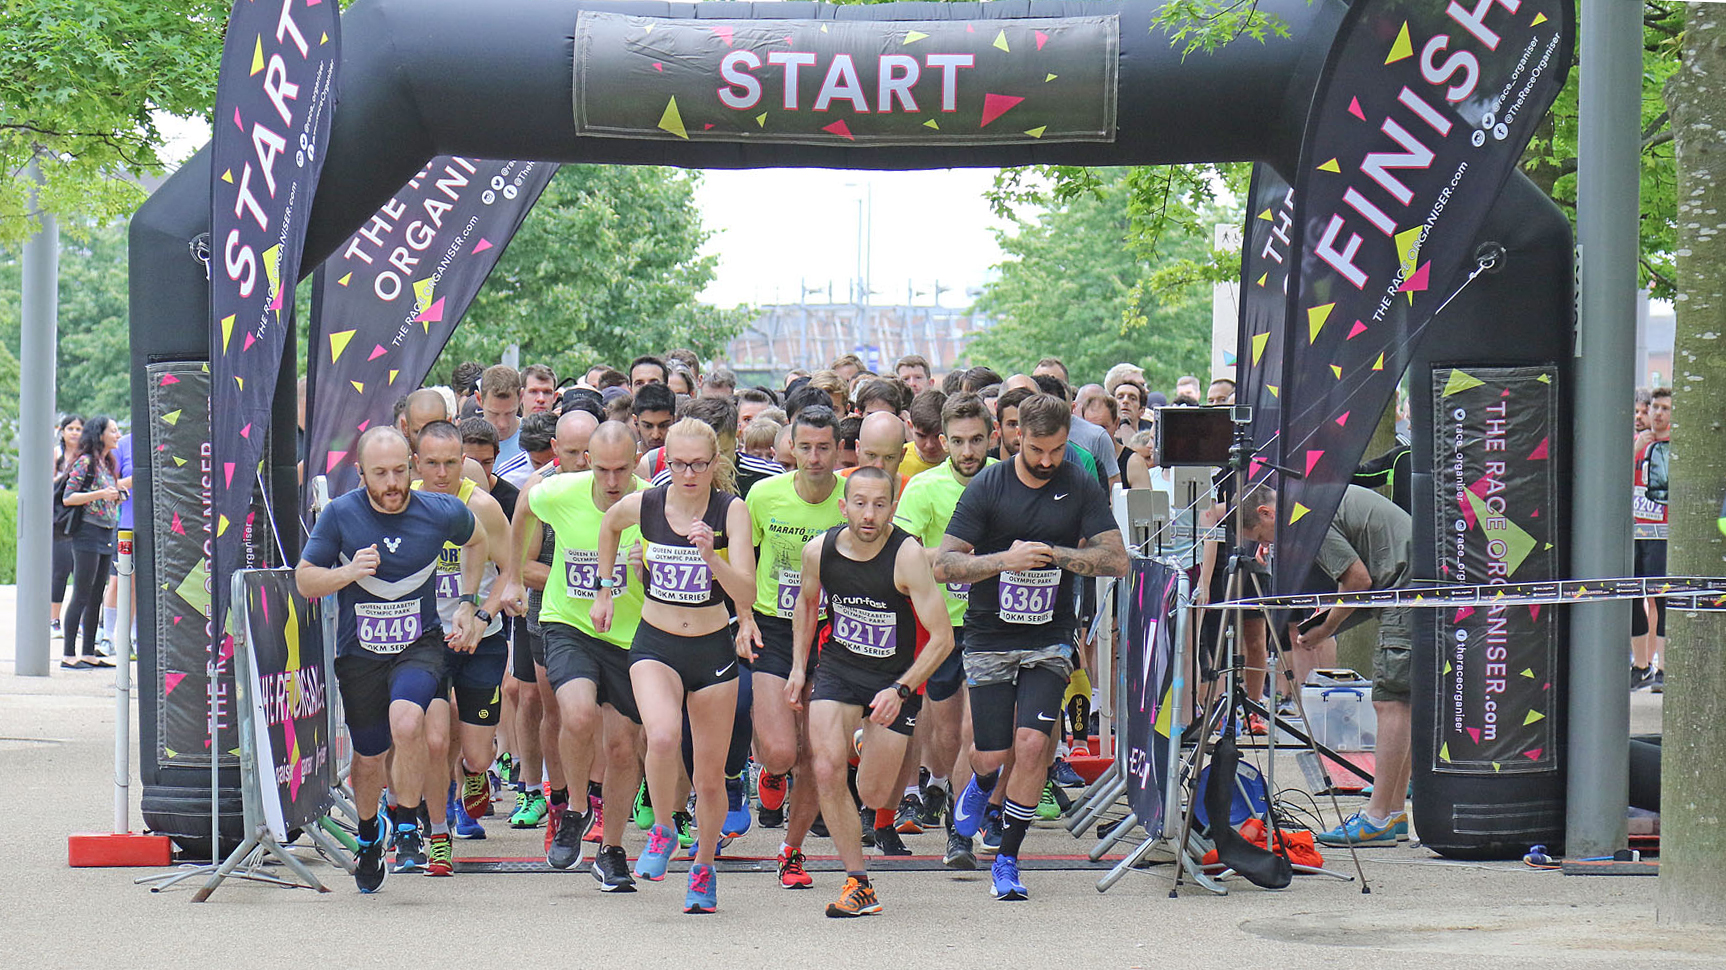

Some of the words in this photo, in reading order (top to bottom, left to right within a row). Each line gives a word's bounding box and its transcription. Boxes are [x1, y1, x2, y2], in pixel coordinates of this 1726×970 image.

[717, 50, 976, 114] START
[1491, 36, 1539, 113] @race_organiser
[1504, 32, 1560, 124] @TheRaceOrganiser
[225, 0, 309, 298] START
[1314, 0, 1522, 290] FINISH
[344, 198, 407, 264] THE
[1373, 296, 1391, 322] THE
[1387, 260, 1411, 297] RACE
[1407, 161, 1468, 260] ORGANISER.com
[256, 314, 269, 340] THE
[263, 279, 277, 315] RACE
[272, 181, 297, 279] ORGANISER.com
[391, 323, 410, 347] THE
[405, 295, 427, 326] RACE
[424, 215, 479, 296] ORGANISER.com
[1485, 401, 1507, 450] THE
[1455, 424, 1465, 502] race_organiser
[1485, 461, 1507, 530] RACE
[769, 524, 806, 536] MARATÓ
[801, 534, 819, 543] BA
[435, 575, 463, 598] 41
[568, 565, 623, 588] 635
[651, 563, 708, 590] 6374
[1009, 576, 1036, 584] OLYMPIC
[383, 602, 415, 610] ELIZABETH
[654, 589, 676, 599] 10KM
[679, 593, 706, 601] SERIES
[843, 597, 887, 609] run-fast
[1000, 585, 1053, 612] 6361
[843, 608, 867, 619] OLYMPIC
[1003, 613, 1024, 621] 10KM
[1028, 613, 1049, 621] SERIES
[360, 615, 418, 642] 6449
[837, 616, 893, 647] 6217
[864, 646, 891, 656] SERIES
[1454, 643, 1465, 733] theraceorganiser
